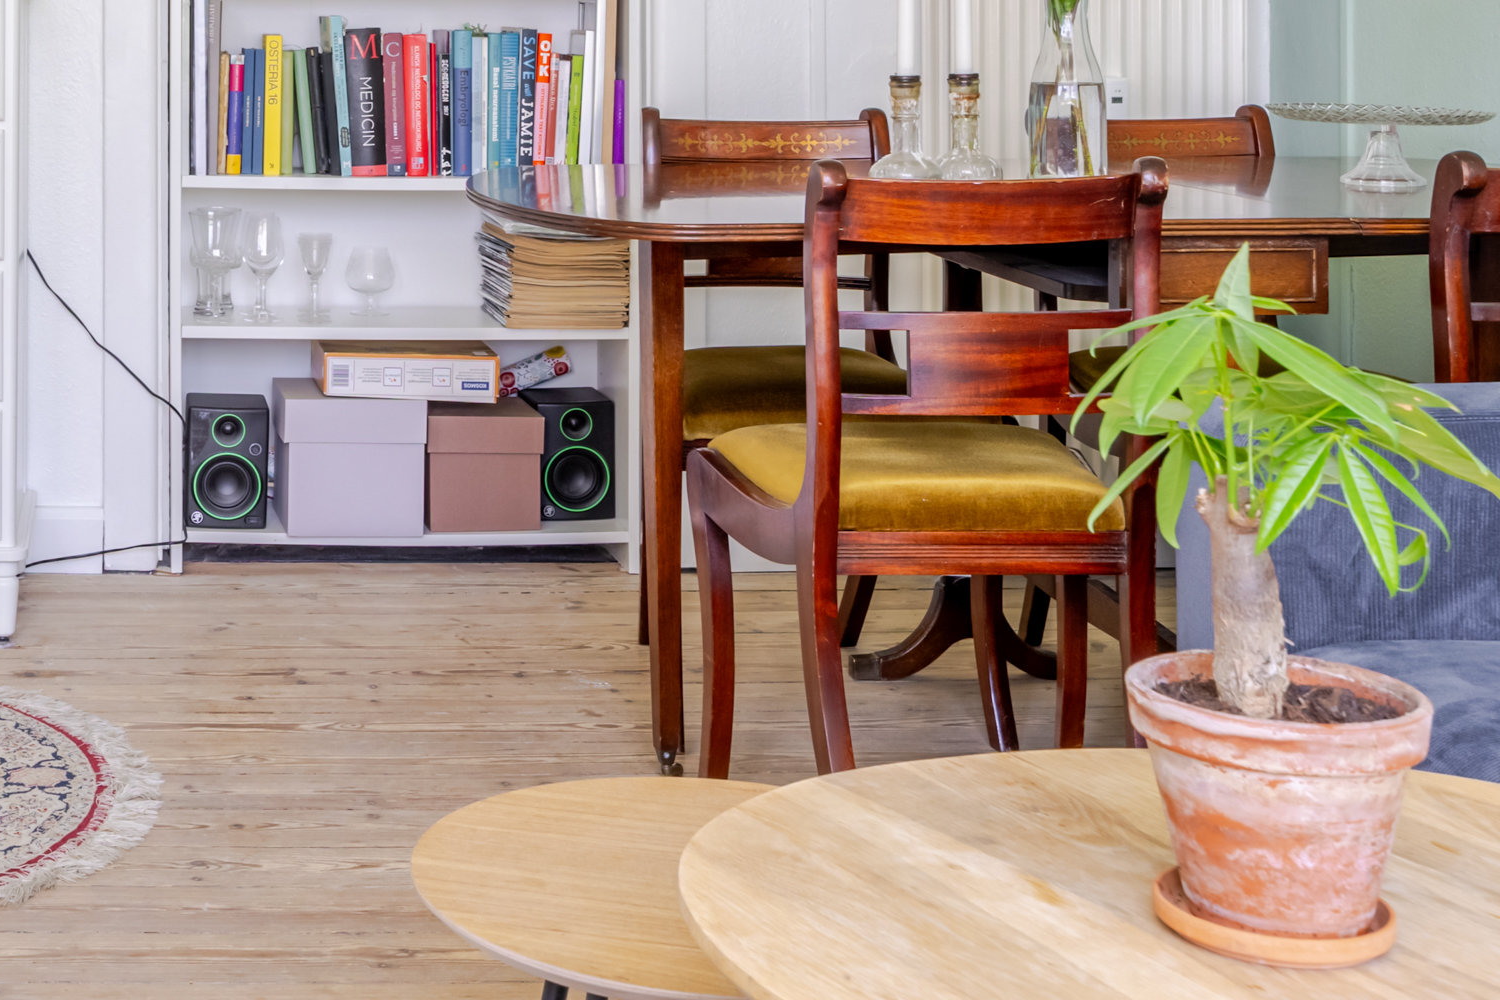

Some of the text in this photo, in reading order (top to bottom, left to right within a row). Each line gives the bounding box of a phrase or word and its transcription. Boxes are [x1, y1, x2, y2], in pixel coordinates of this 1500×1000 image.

[350, 33, 379, 60] M
[386, 42, 400, 57] C
[522, 37, 535, 80] SAVE
[539, 40, 550, 77] OTK
[268, 40, 279, 105] OSTERIA 16
[502, 56, 516, 90] PSYKIATRI
[360, 77, 375, 147] MEDICIN
[415, 101, 421, 109] OG
[458, 70, 468, 127] Embryologi
[492, 67, 500, 142] Basal neuroanatomi
[520, 99, 533, 156] JAMIE
